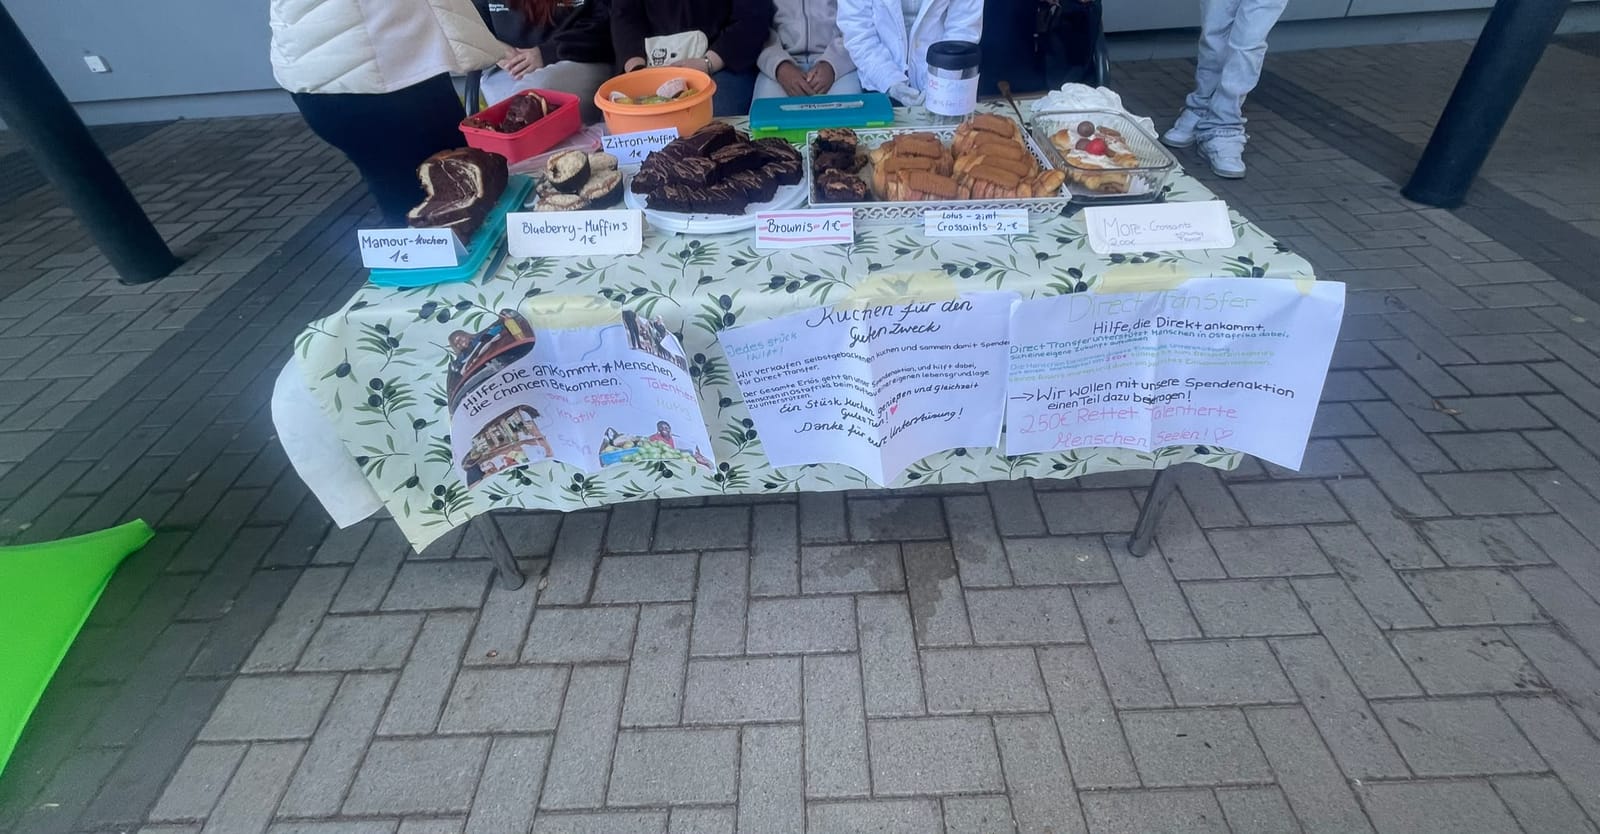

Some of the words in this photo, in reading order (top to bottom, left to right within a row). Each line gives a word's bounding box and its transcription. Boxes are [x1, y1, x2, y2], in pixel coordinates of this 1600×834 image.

[580, 235, 597, 245] 1€
[389, 250, 409, 263] 1€
[941, 298, 973, 313] den
[1092, 319, 1132, 335] Hilfe,
[1132, 318, 1152, 331] die
[735, 370, 753, 380] Wir
[901, 344, 918, 352] und
[501, 370, 530, 385] Die
[914, 384, 933, 396] und
[1115, 377, 1139, 389] mit
[1185, 378, 1295, 398] Spendenaktion
[469, 399, 492, 418] die
[1047, 400, 1079, 410] einen
[794, 421, 844, 434] Danke
